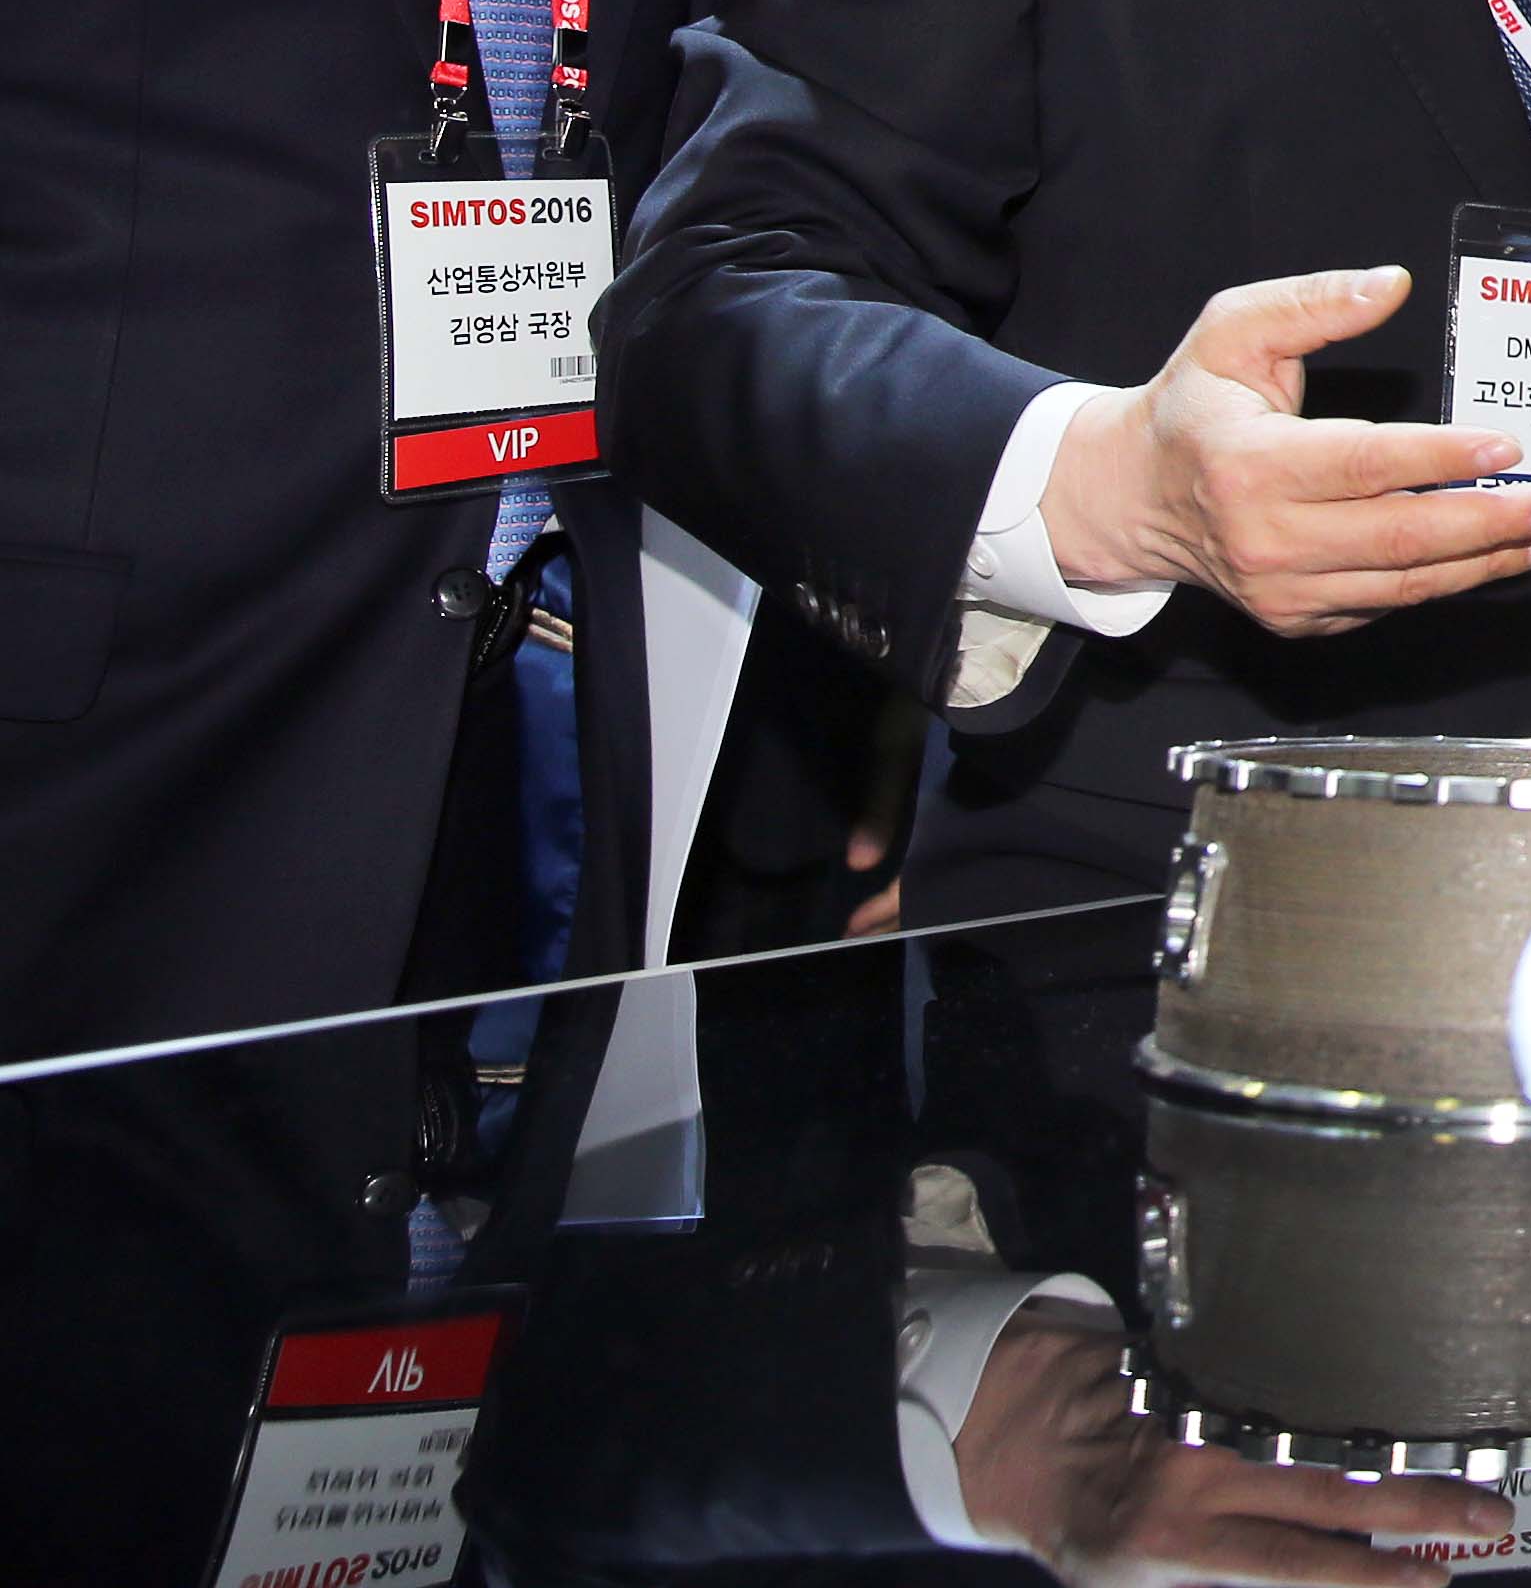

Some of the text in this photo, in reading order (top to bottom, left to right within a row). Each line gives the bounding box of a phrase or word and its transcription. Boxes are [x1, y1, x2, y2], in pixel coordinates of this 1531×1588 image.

[427, 261, 588, 296] 산업통상자원부
[449, 310, 572, 346] 김영삼 국장
[488, 427, 539, 462] VIP
